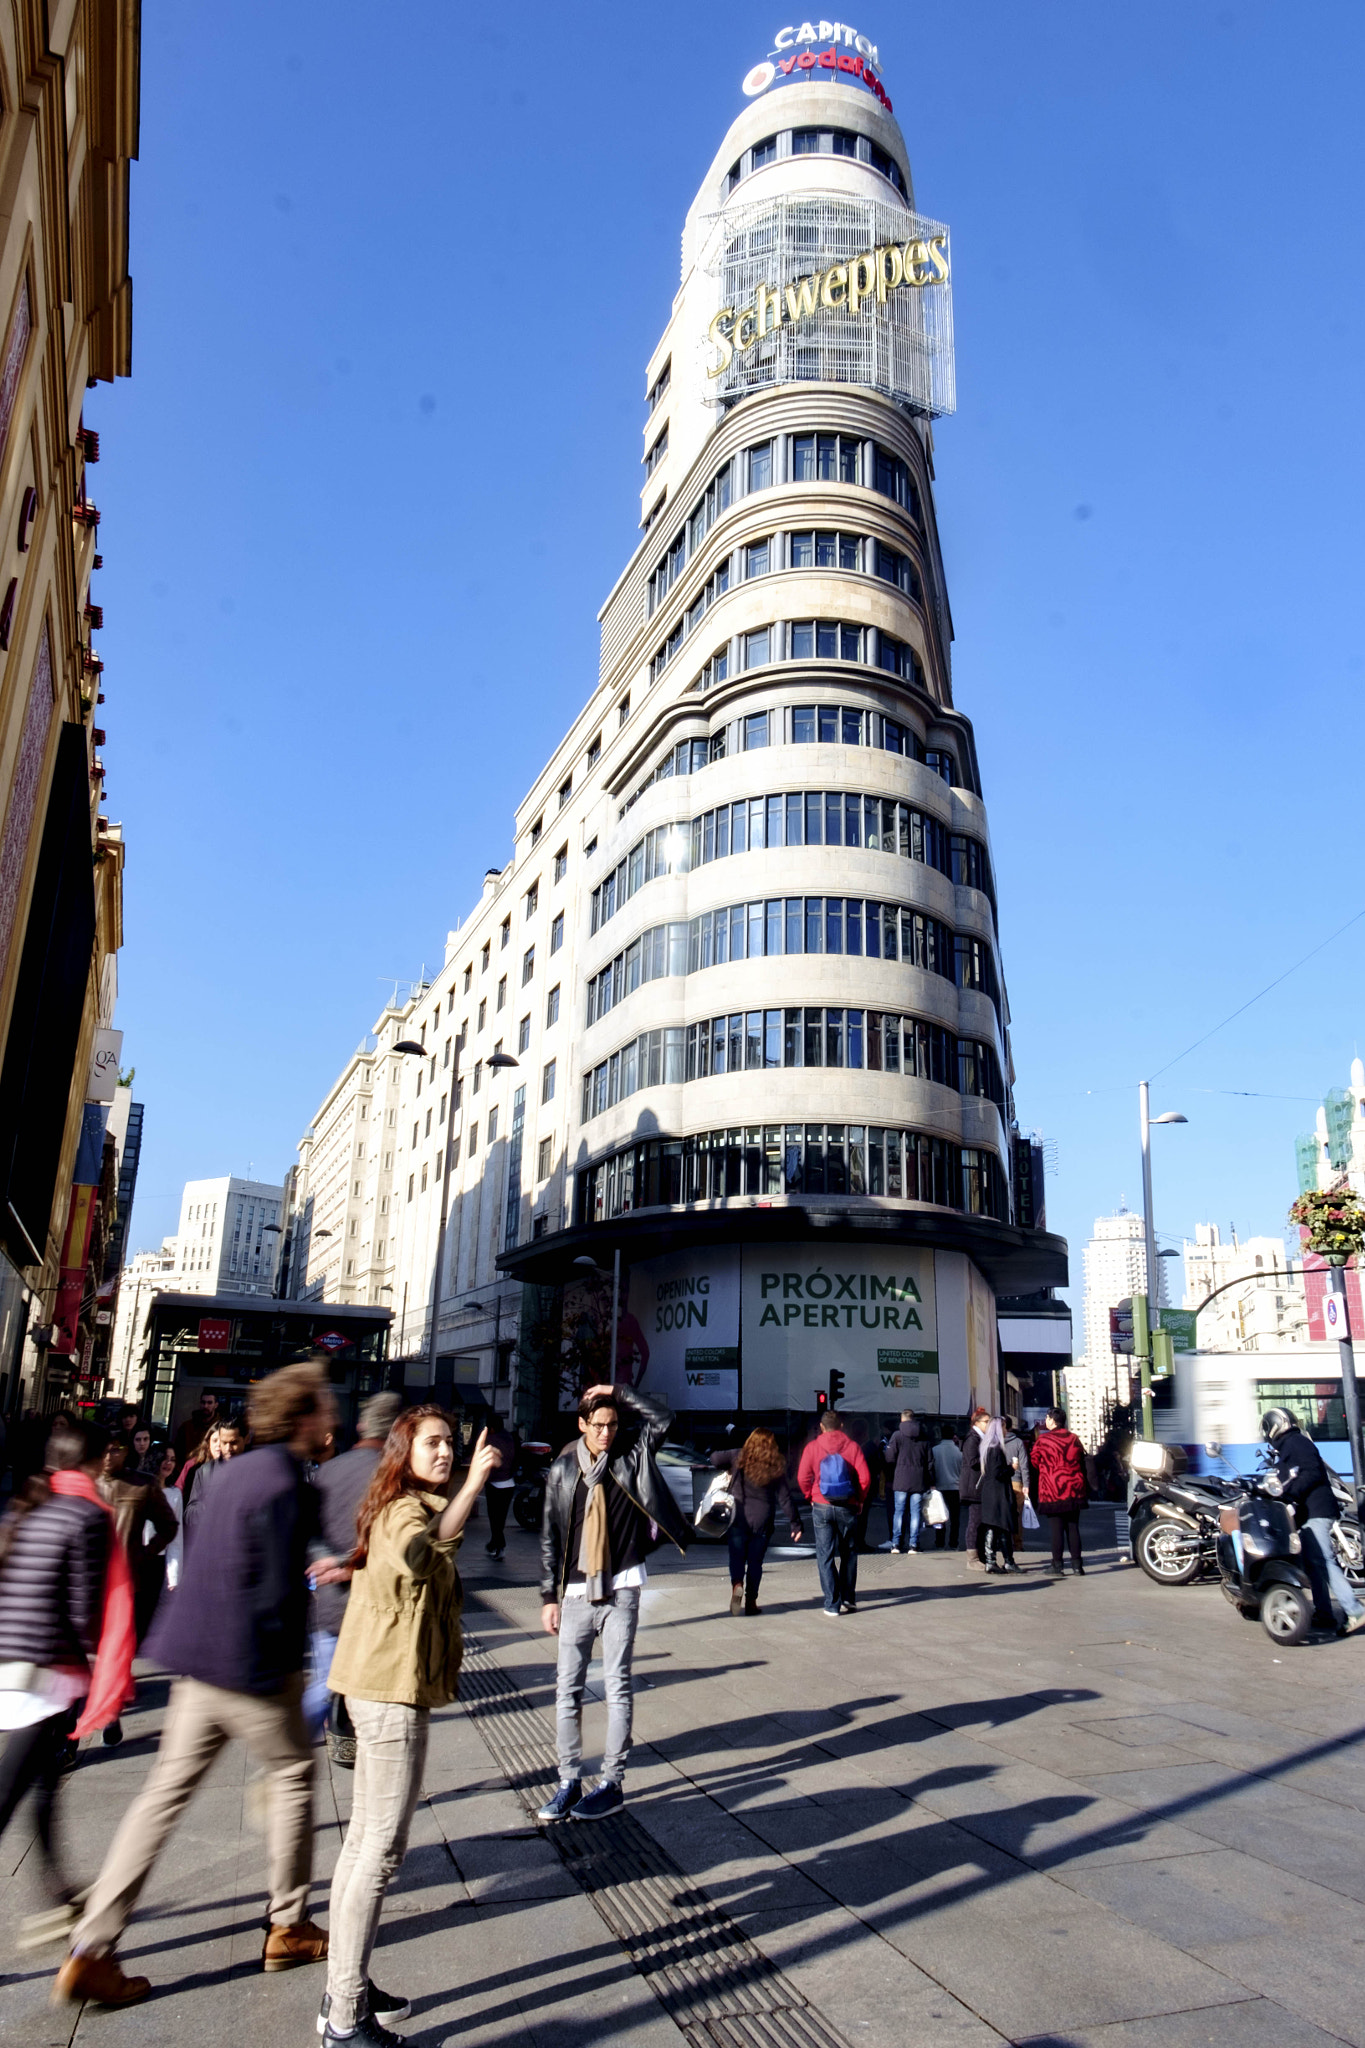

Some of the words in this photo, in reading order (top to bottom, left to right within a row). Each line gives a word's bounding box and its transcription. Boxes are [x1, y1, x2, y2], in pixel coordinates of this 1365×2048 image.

[775, 21, 883, 74] CAPITOL
[707, 236, 949, 379] Schweppes
[1018, 1144, 1031, 1224] HOTEL
[656, 1276, 710, 1301] OPENING
[761, 1266, 922, 1303] PRÓXIMA
[656, 1300, 708, 1333] SOON
[759, 1303, 923, 1331] APERTURA
[323, 1336, 343, 1345] Metro
